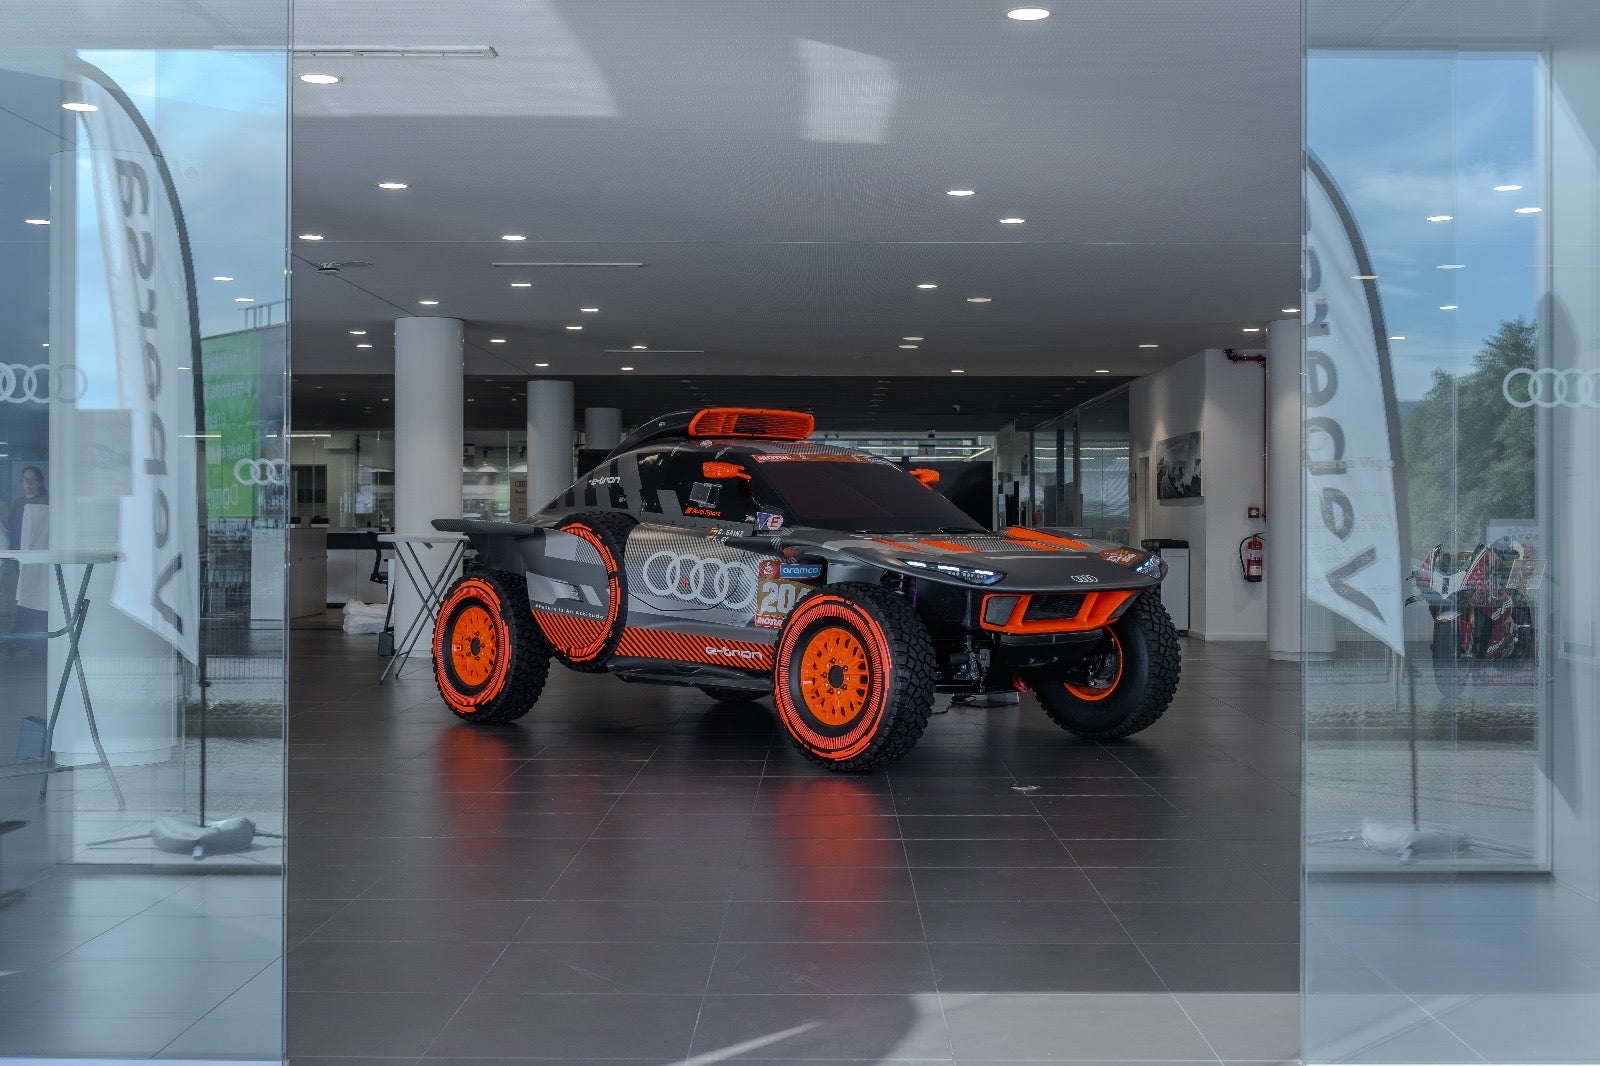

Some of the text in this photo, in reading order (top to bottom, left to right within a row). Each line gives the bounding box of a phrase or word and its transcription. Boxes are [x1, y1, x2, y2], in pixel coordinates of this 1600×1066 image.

[590, 476, 621, 486] e-tron
[782, 566, 818, 575] aramco
[705, 646, 763, 660] e-tron
